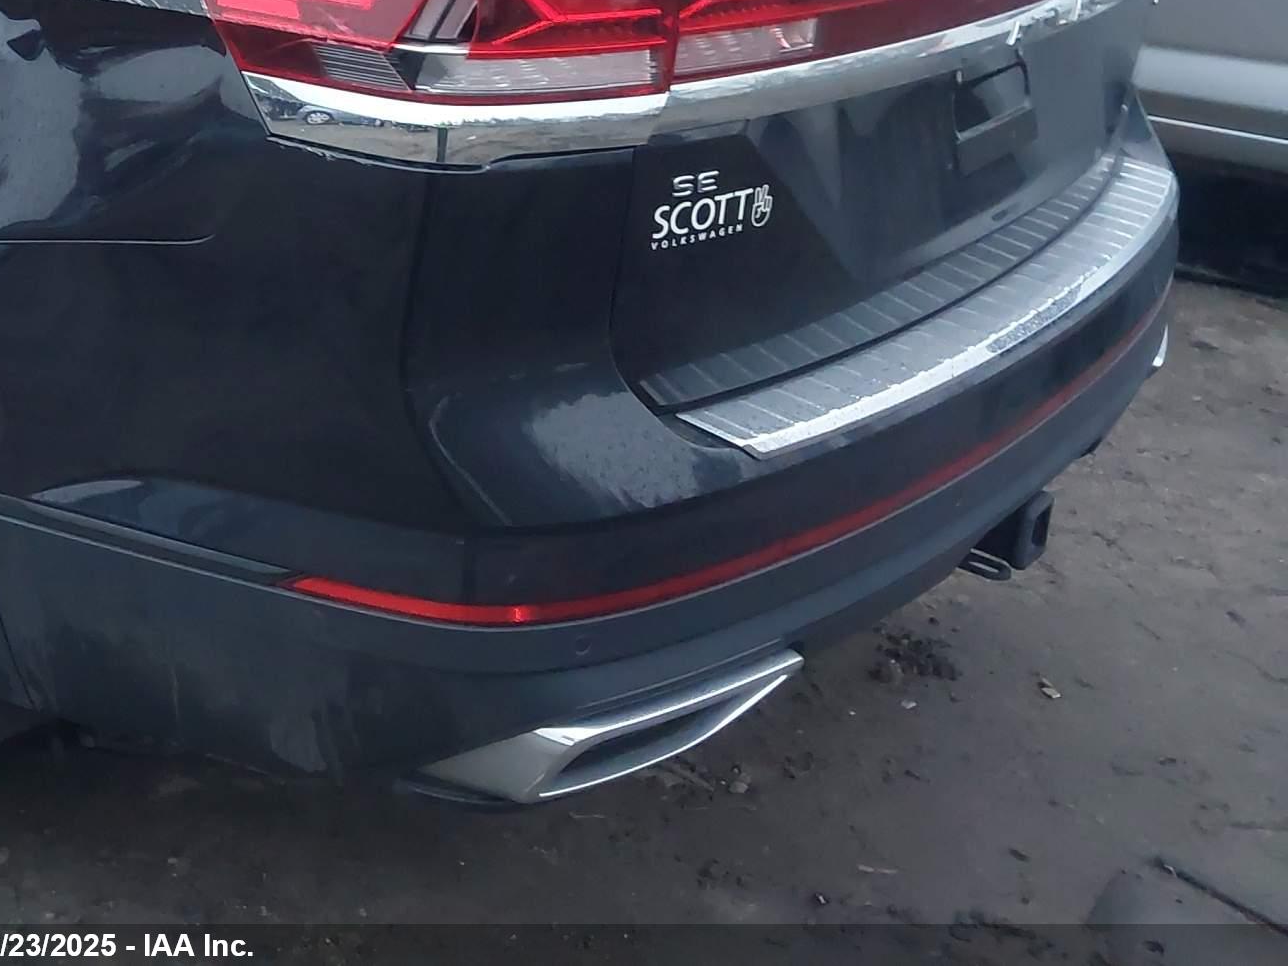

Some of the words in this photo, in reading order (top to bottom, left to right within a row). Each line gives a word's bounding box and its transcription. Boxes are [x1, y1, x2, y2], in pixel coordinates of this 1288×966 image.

[672, 170, 720, 197] SE
[652, 187, 754, 239] SCOTT
[651, 223, 743, 250] VOLKSWAGEN
